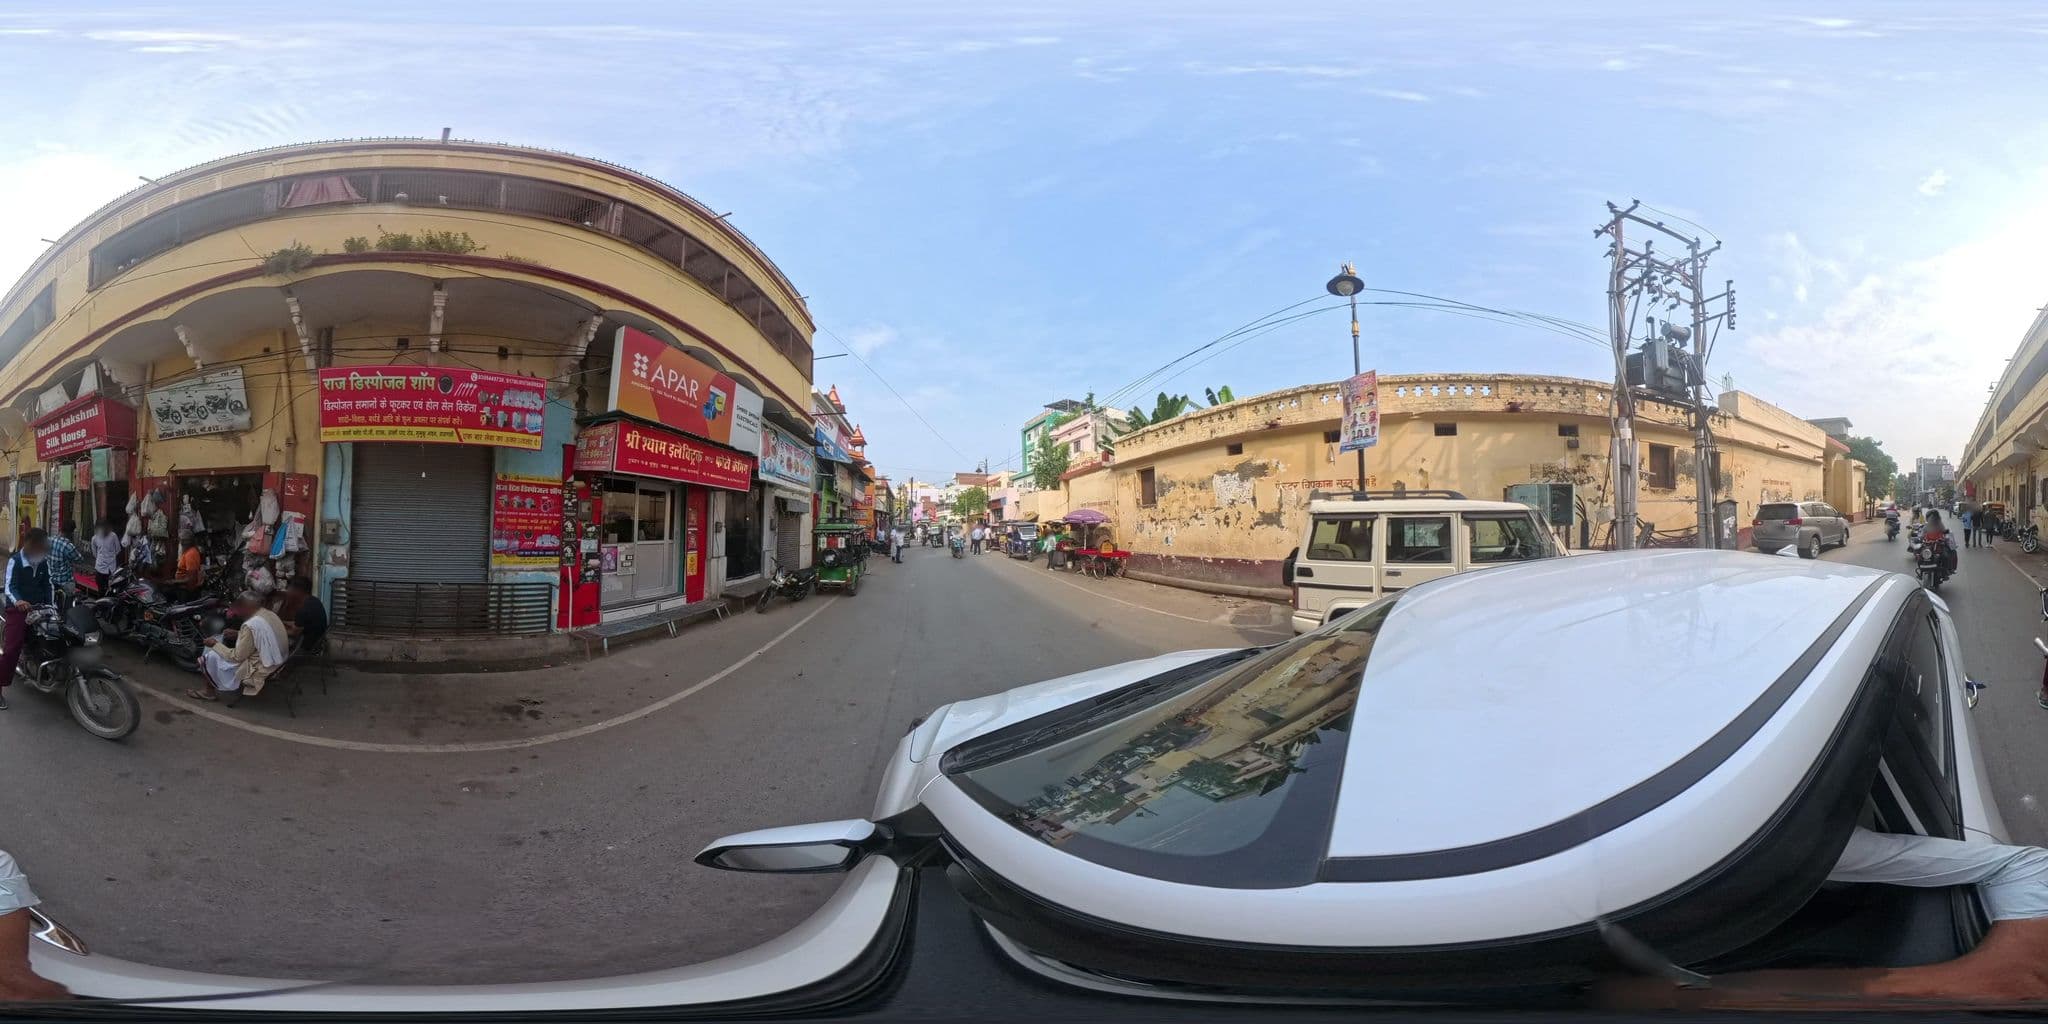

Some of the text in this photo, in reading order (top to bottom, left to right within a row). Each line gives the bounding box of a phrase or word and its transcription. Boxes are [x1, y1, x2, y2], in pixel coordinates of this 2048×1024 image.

[322, 371, 436, 391] राज डिस्पोजल शॉप
[651, 364, 699, 401] APAR
[323, 398, 353, 411] डिस्पोजल
[379, 397, 387, 409] के
[413, 398, 423, 410] एवं
[425, 398, 439, 411] होल
[441, 399, 454, 411] सेल
[37, 404, 99, 438] Varsha Lakshmi
[46, 436, 60, 449] Silk
[60, 428, 87, 444] House
[625, 430, 641, 450] श्री
[642, 436, 667, 456] श्याम
